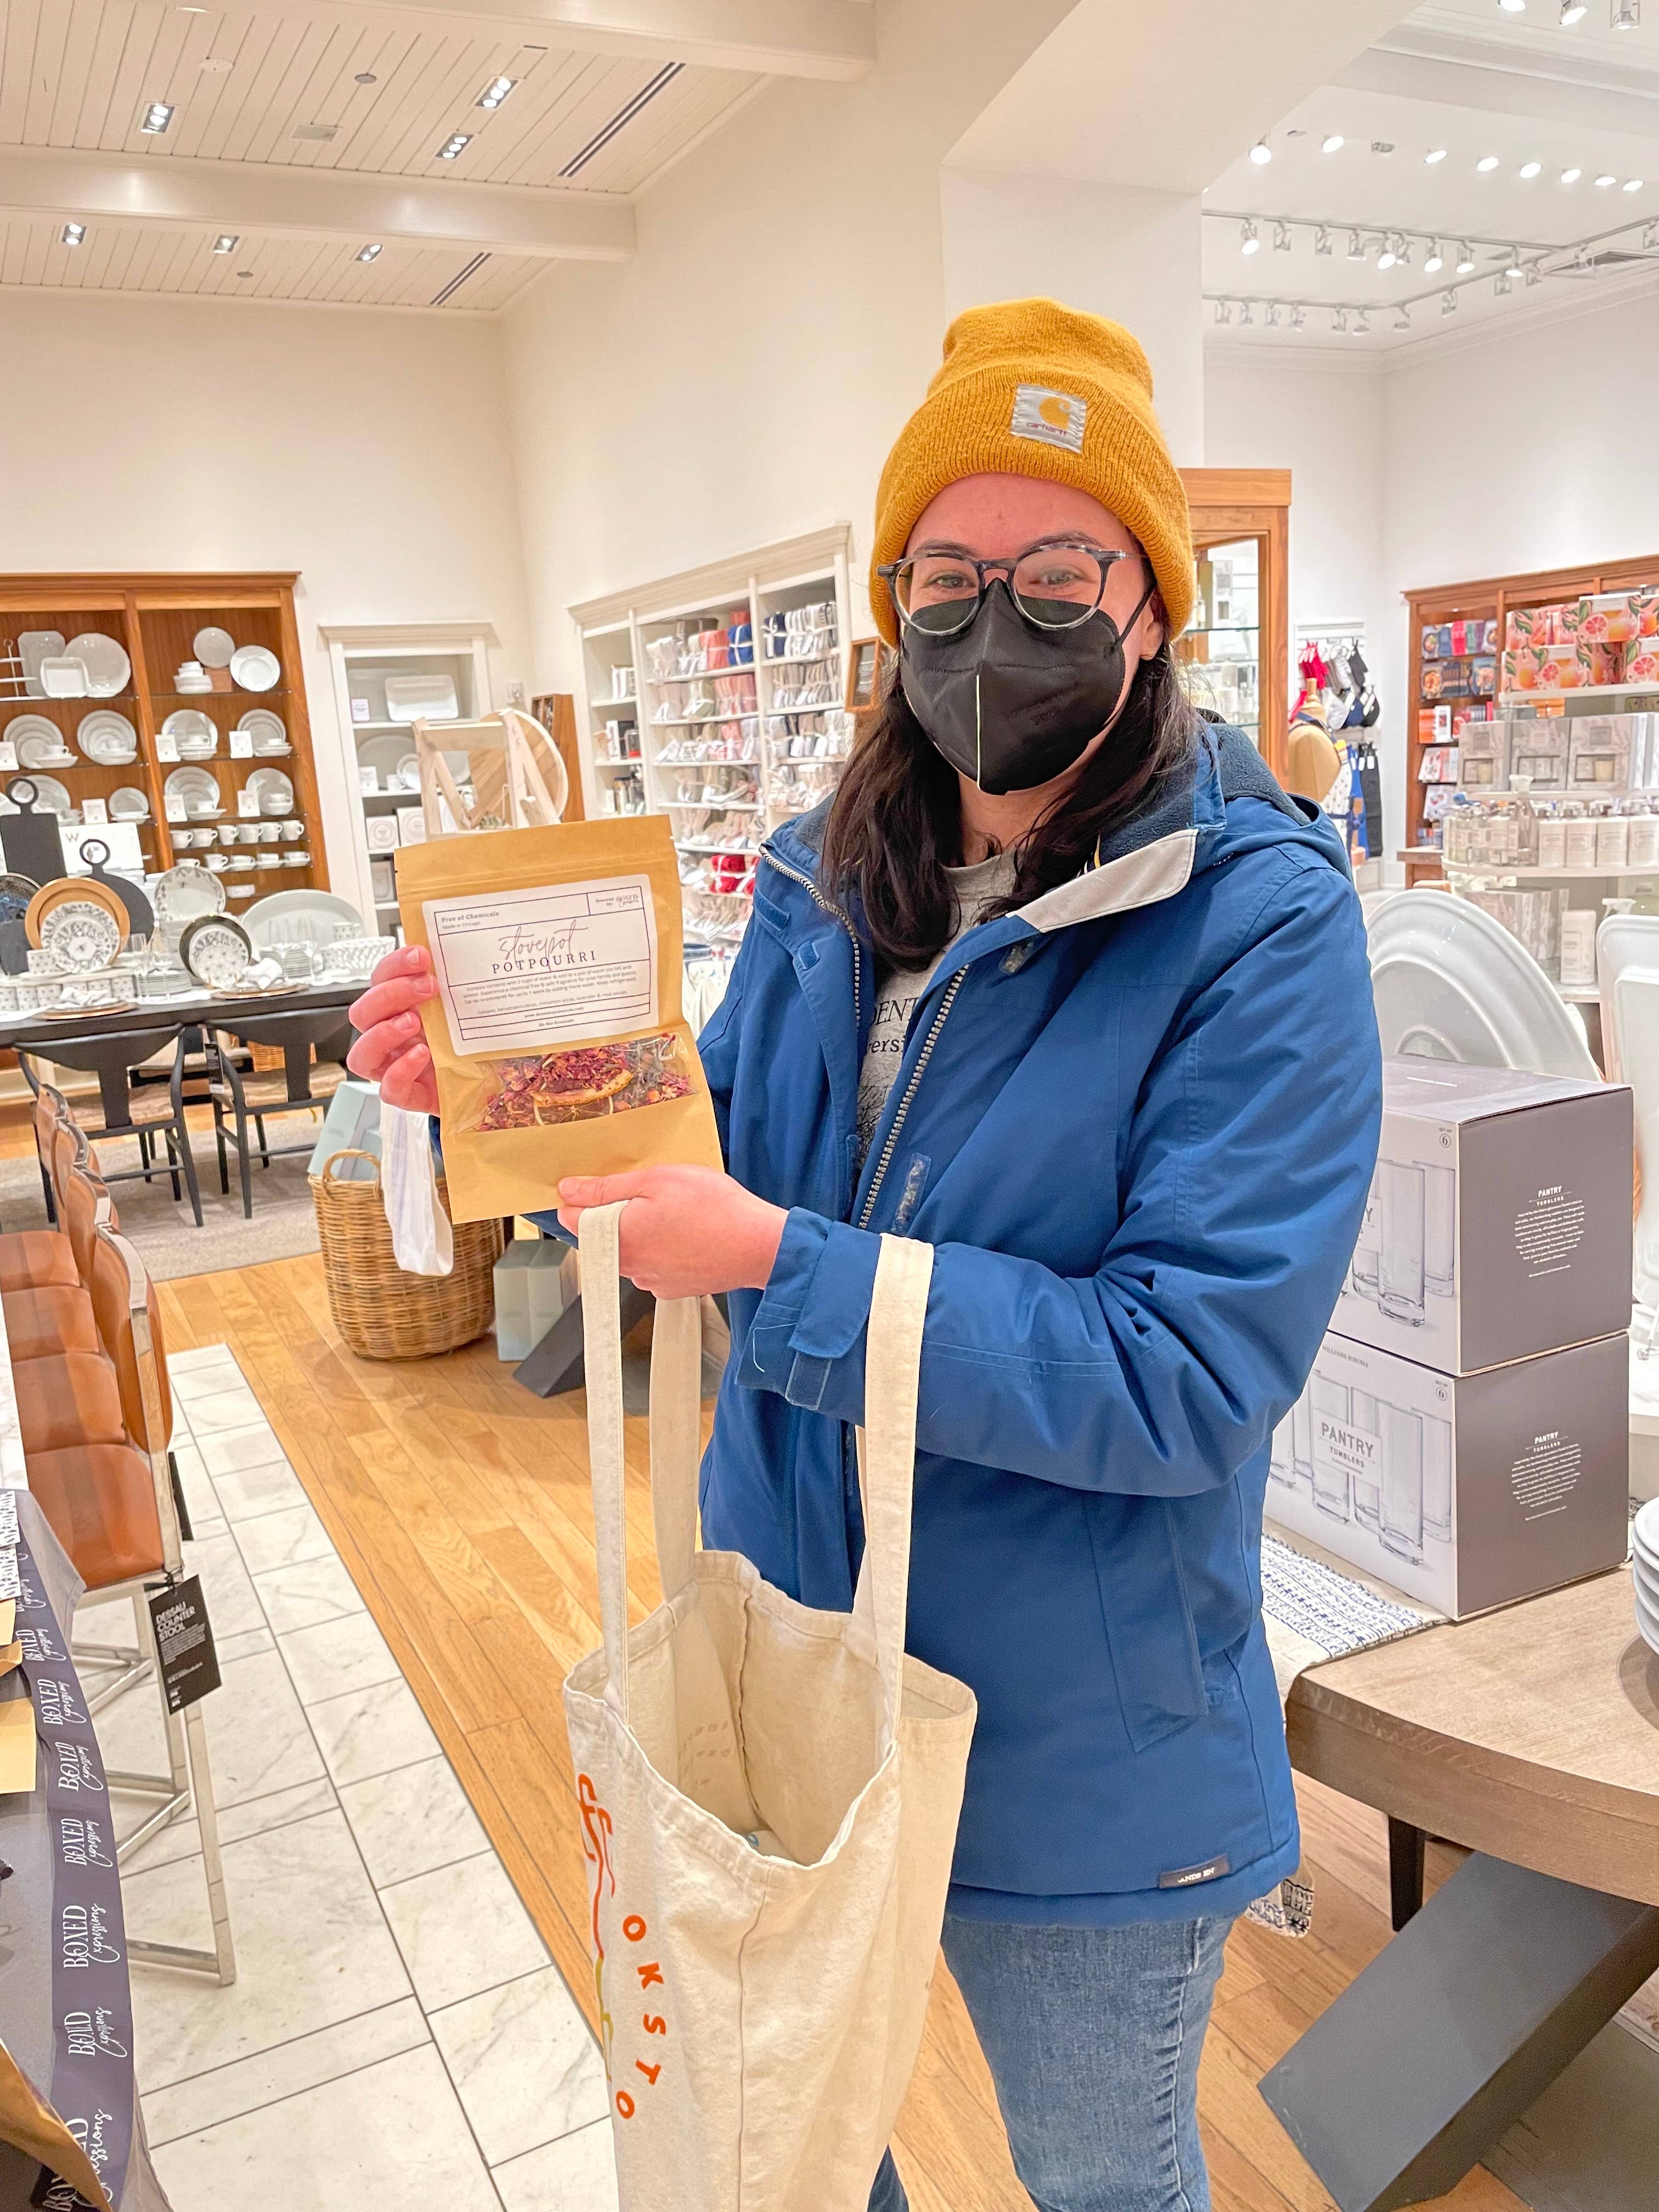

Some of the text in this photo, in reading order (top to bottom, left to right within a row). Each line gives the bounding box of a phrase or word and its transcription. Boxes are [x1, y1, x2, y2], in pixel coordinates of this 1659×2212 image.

[1026, 422, 1066, 436] carhartt
[466, 911, 499, 920] Chemicals
[499, 919, 589, 972] stovepot
[492, 951, 596, 974] POTPOURRI
[1538, 1186, 1562, 1198] PANTRY
[1322, 1345, 1369, 1368] WILLIAMS SONOMA
[1321, 1421, 1373, 1458] PANTRY
[1534, 1431, 1559, 1444] PANTRY
[1330, 1446, 1364, 1468] TUMBLERS
[156, 1601, 187, 1625] DESSAU
[157, 1605, 196, 1633] COUNTER
[159, 1622, 186, 1642] STOOL
[37, 1679, 63, 1725] BOXED
[55, 1741, 80, 1792] BOXED
[61, 1818, 87, 1866] BOXED
[63, 1905, 89, 1968] BOXED
